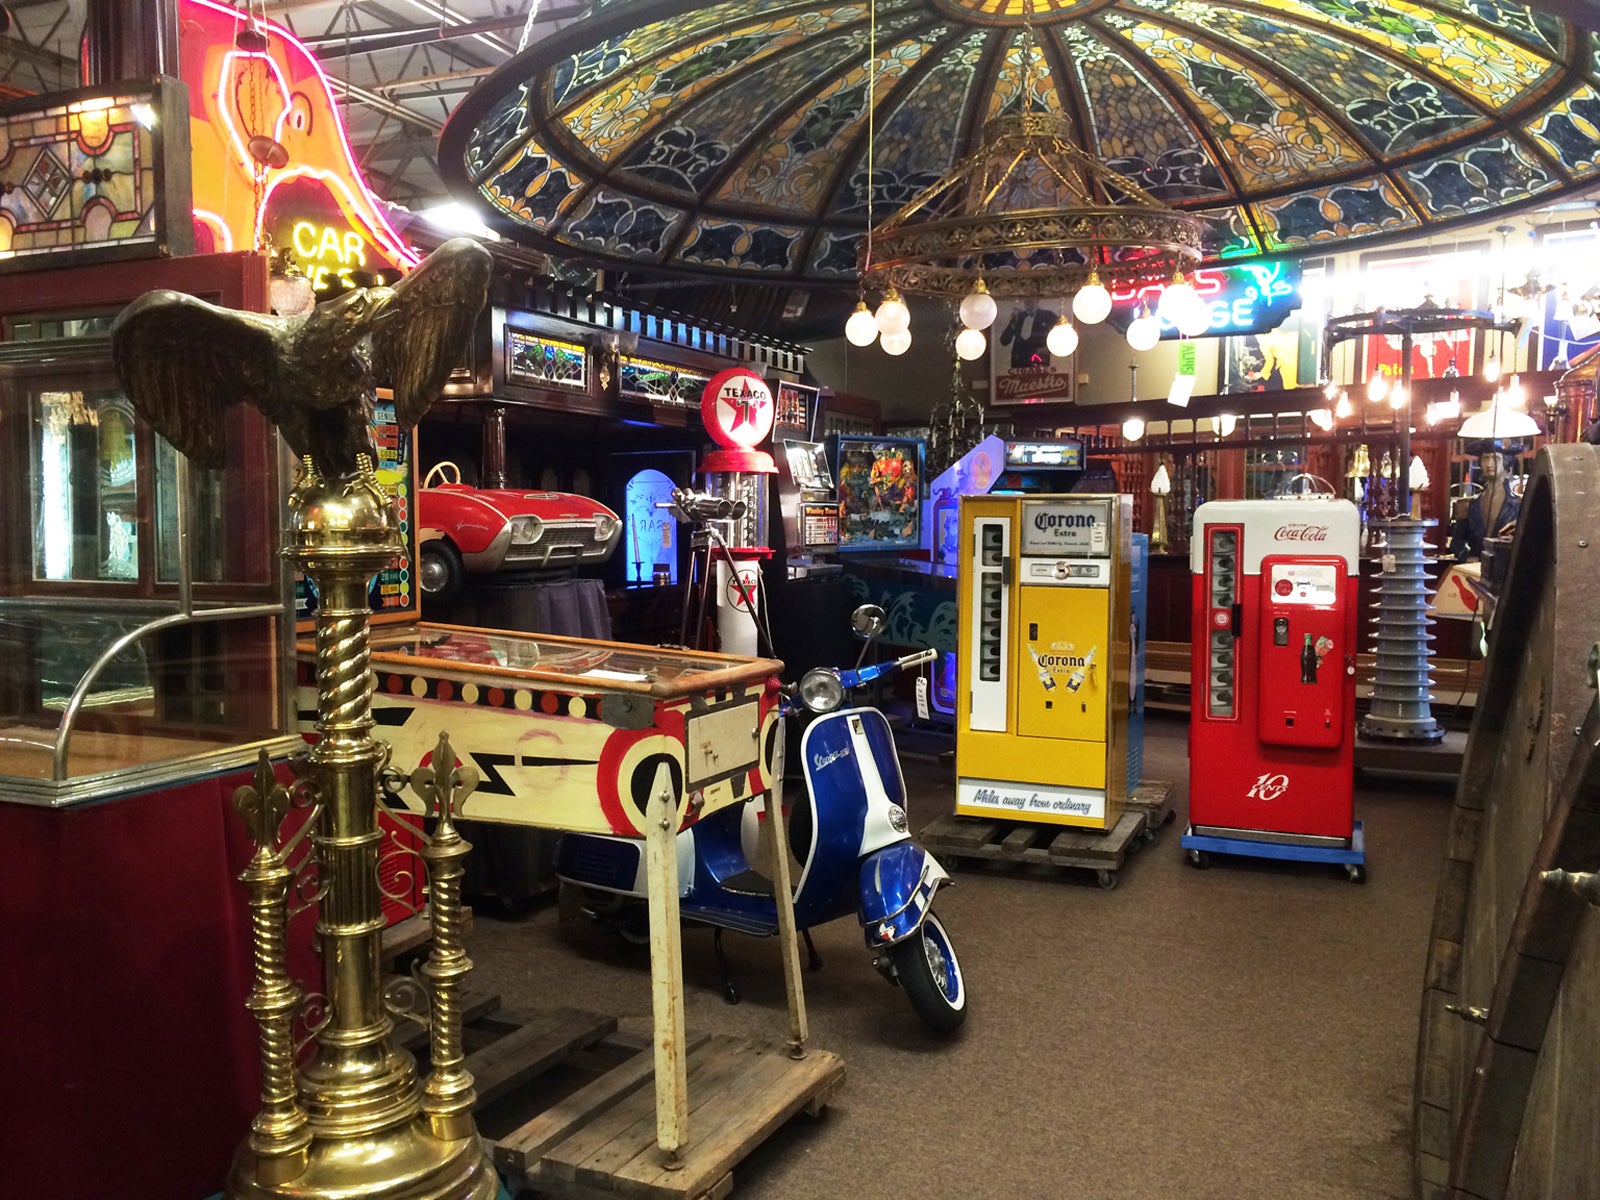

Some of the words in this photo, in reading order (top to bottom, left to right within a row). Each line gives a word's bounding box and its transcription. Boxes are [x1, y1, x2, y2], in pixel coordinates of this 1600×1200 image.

[293, 221, 366, 267] CAR
[724, 387, 767, 400] TEXACO
[999, 375, 1067, 397] Maestro
[1273, 525, 1329, 541] Coca-Cola
[1037, 654, 1085, 667] Corona
[1246, 772, 1290, 801] 10
[973, 789, 999, 804] Miles
[1002, 796, 1026, 809] away
[1029, 793, 1051, 808] from
[1052, 798, 1091, 815] ordinary
